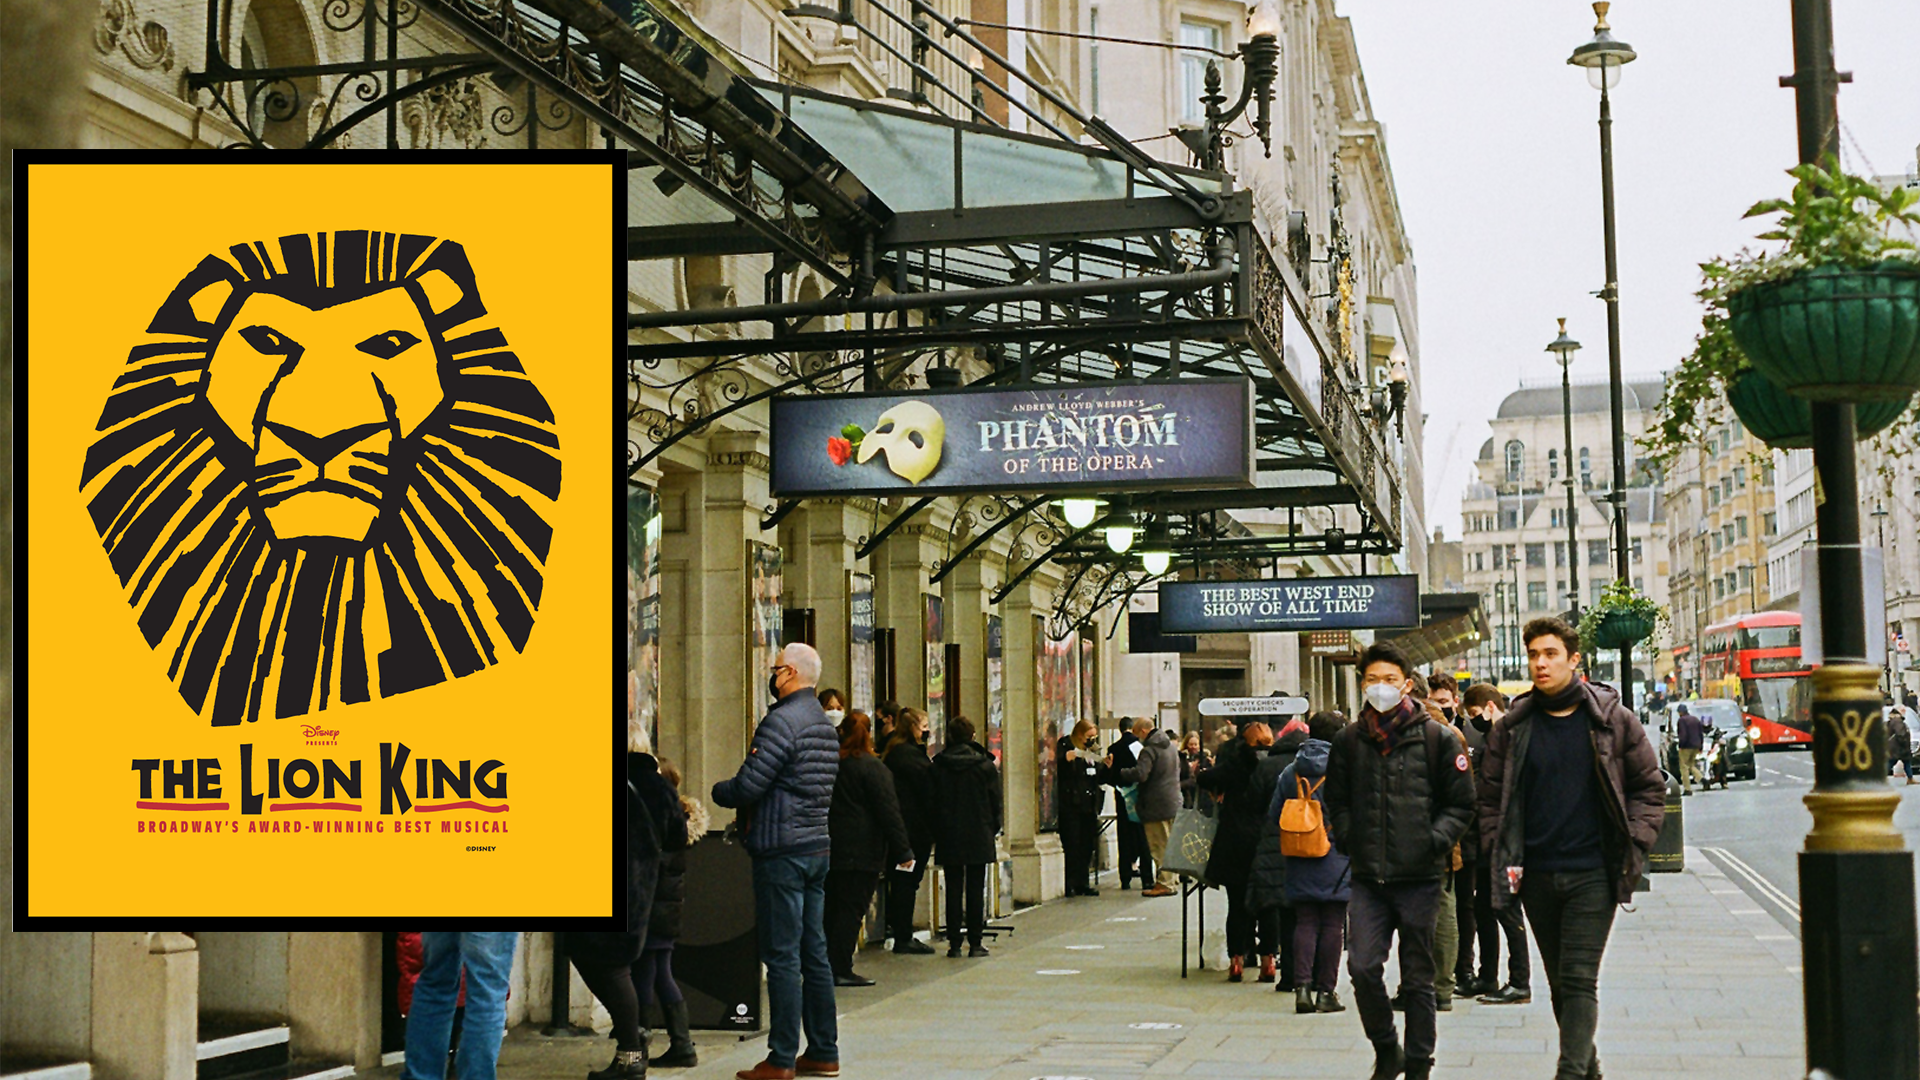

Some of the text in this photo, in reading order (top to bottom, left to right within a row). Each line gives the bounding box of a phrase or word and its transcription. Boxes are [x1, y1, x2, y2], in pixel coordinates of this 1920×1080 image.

[1012, 399, 1145, 412] ANDREW LLOYD WEBBER'S
[977, 412, 1179, 452] PHANTOM
[1004, 454, 1153, 474] OF THE OPERA
[1200, 584, 1375, 602] THE BEST WEST END
[1203, 602, 1255, 617] SHOW
[1258, 601, 1282, 616] OF
[1286, 600, 1320, 615] ALL
